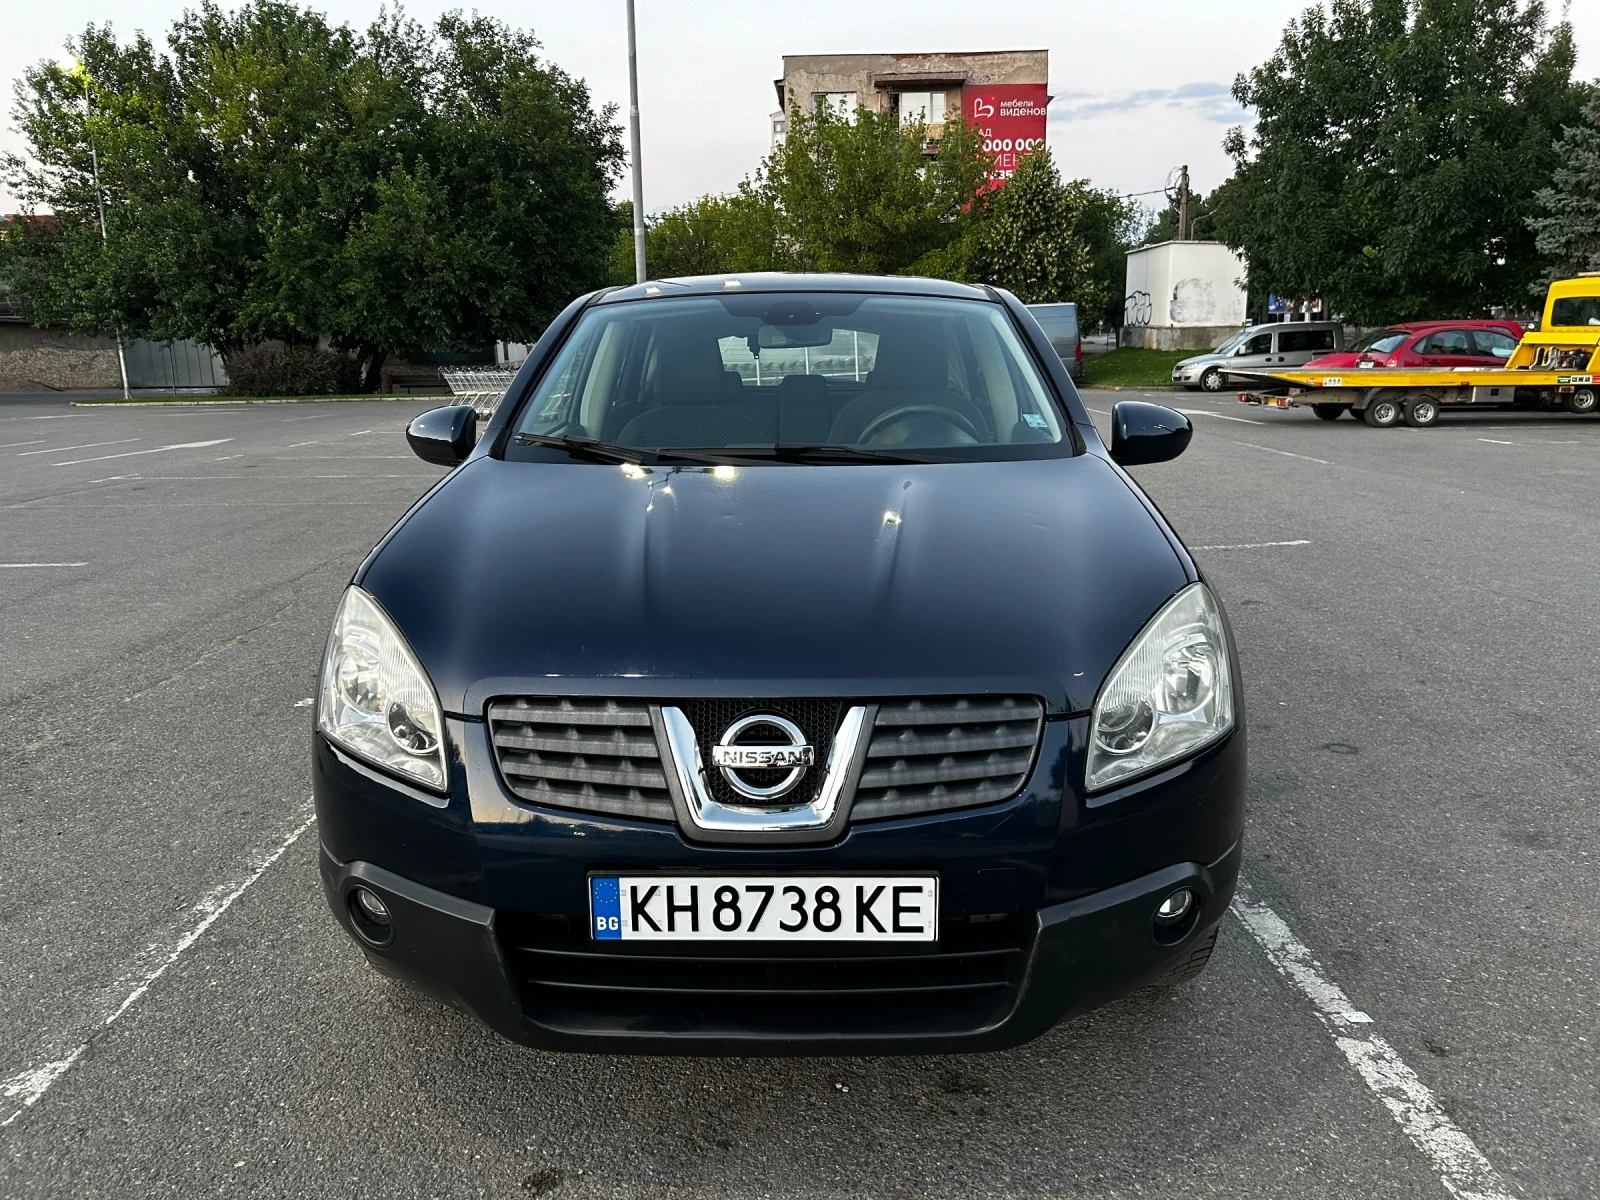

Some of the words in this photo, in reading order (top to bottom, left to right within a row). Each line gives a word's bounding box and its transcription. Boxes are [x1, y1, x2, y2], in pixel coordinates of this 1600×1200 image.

[1000, 99, 1034, 108] мебели
[723, 750, 803, 764] NISSAN
[629, 885, 700, 932] KH
[712, 885, 842, 932] 8738
[854, 885, 925, 933] KE
[596, 916, 619, 931] BG
